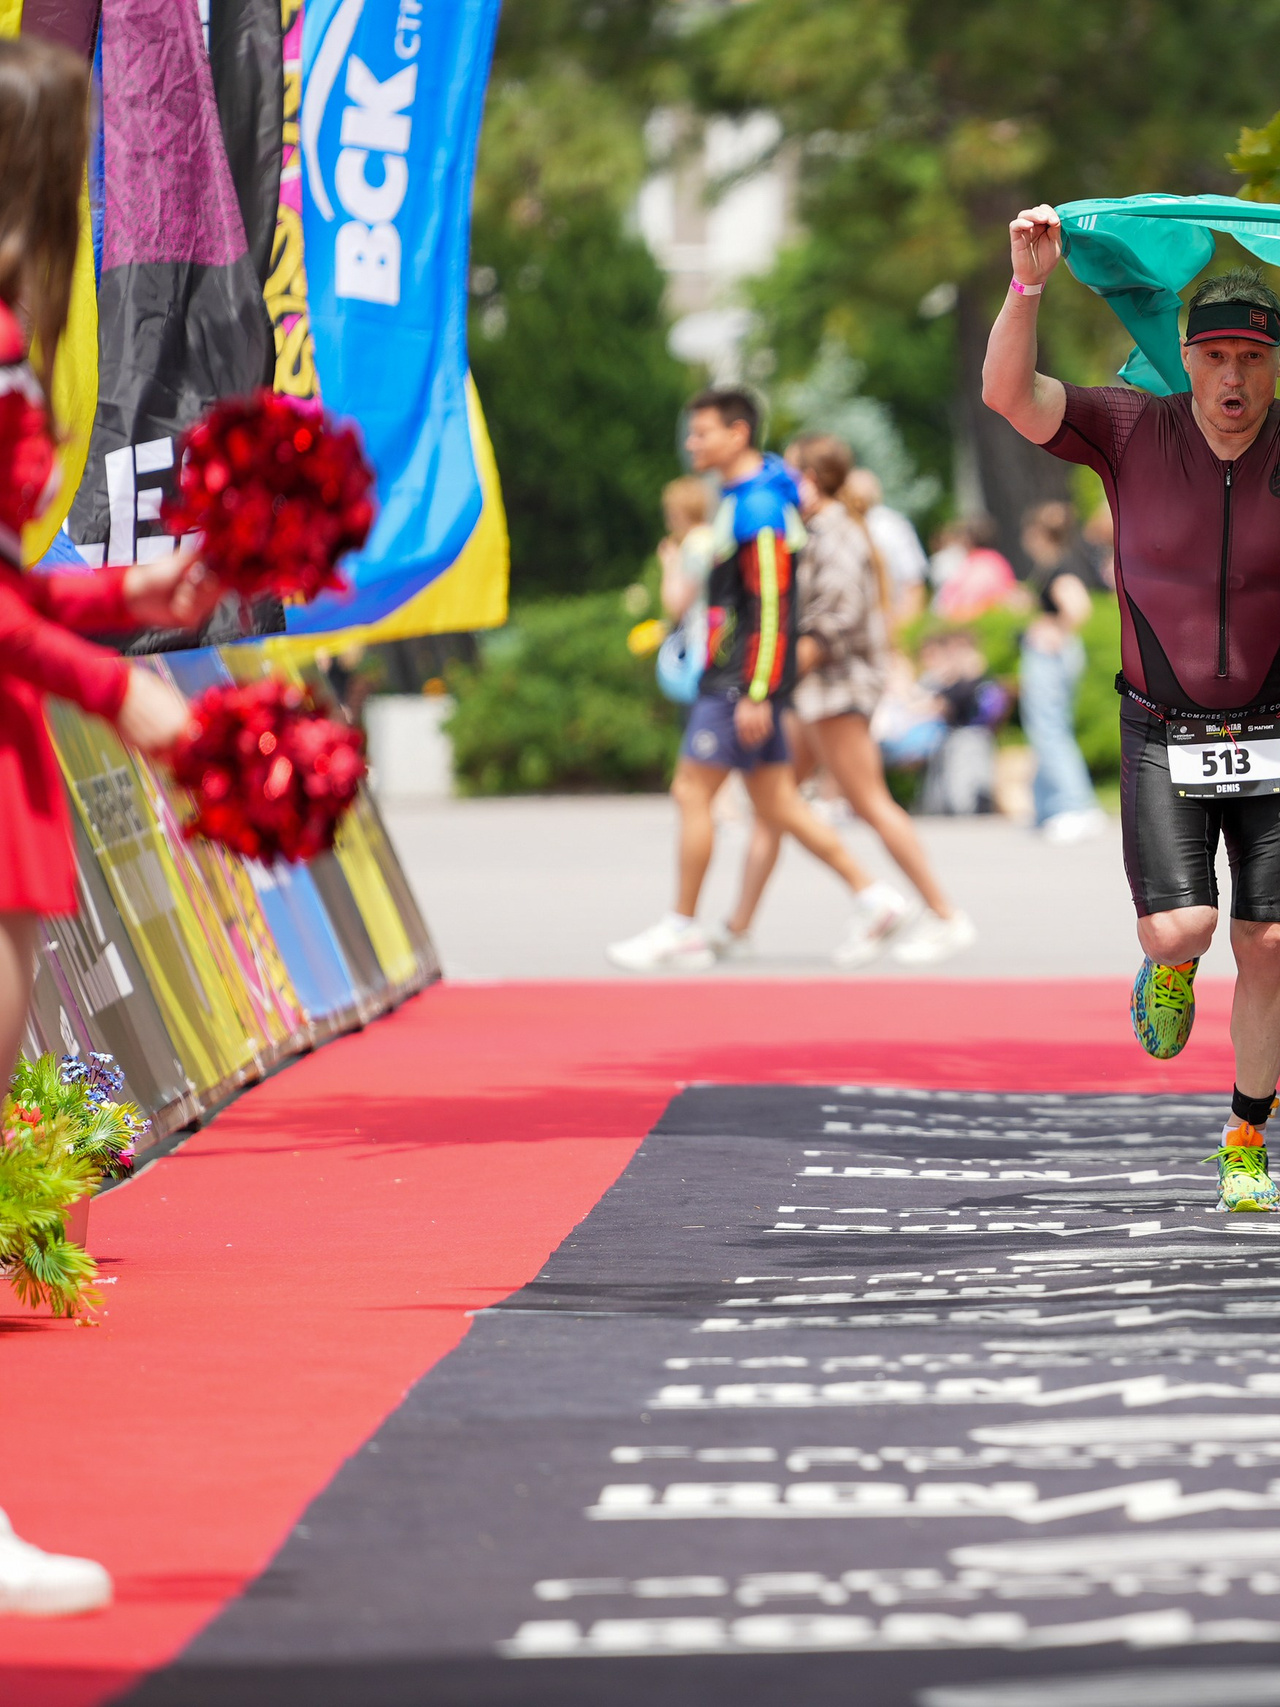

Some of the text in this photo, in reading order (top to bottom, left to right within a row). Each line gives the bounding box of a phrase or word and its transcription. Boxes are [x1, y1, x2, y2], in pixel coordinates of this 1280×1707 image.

[1202, 748, 1251, 777] 513
[1216, 783, 1240, 794] DENIS
[774, 1222, 1065, 1232] IRON
